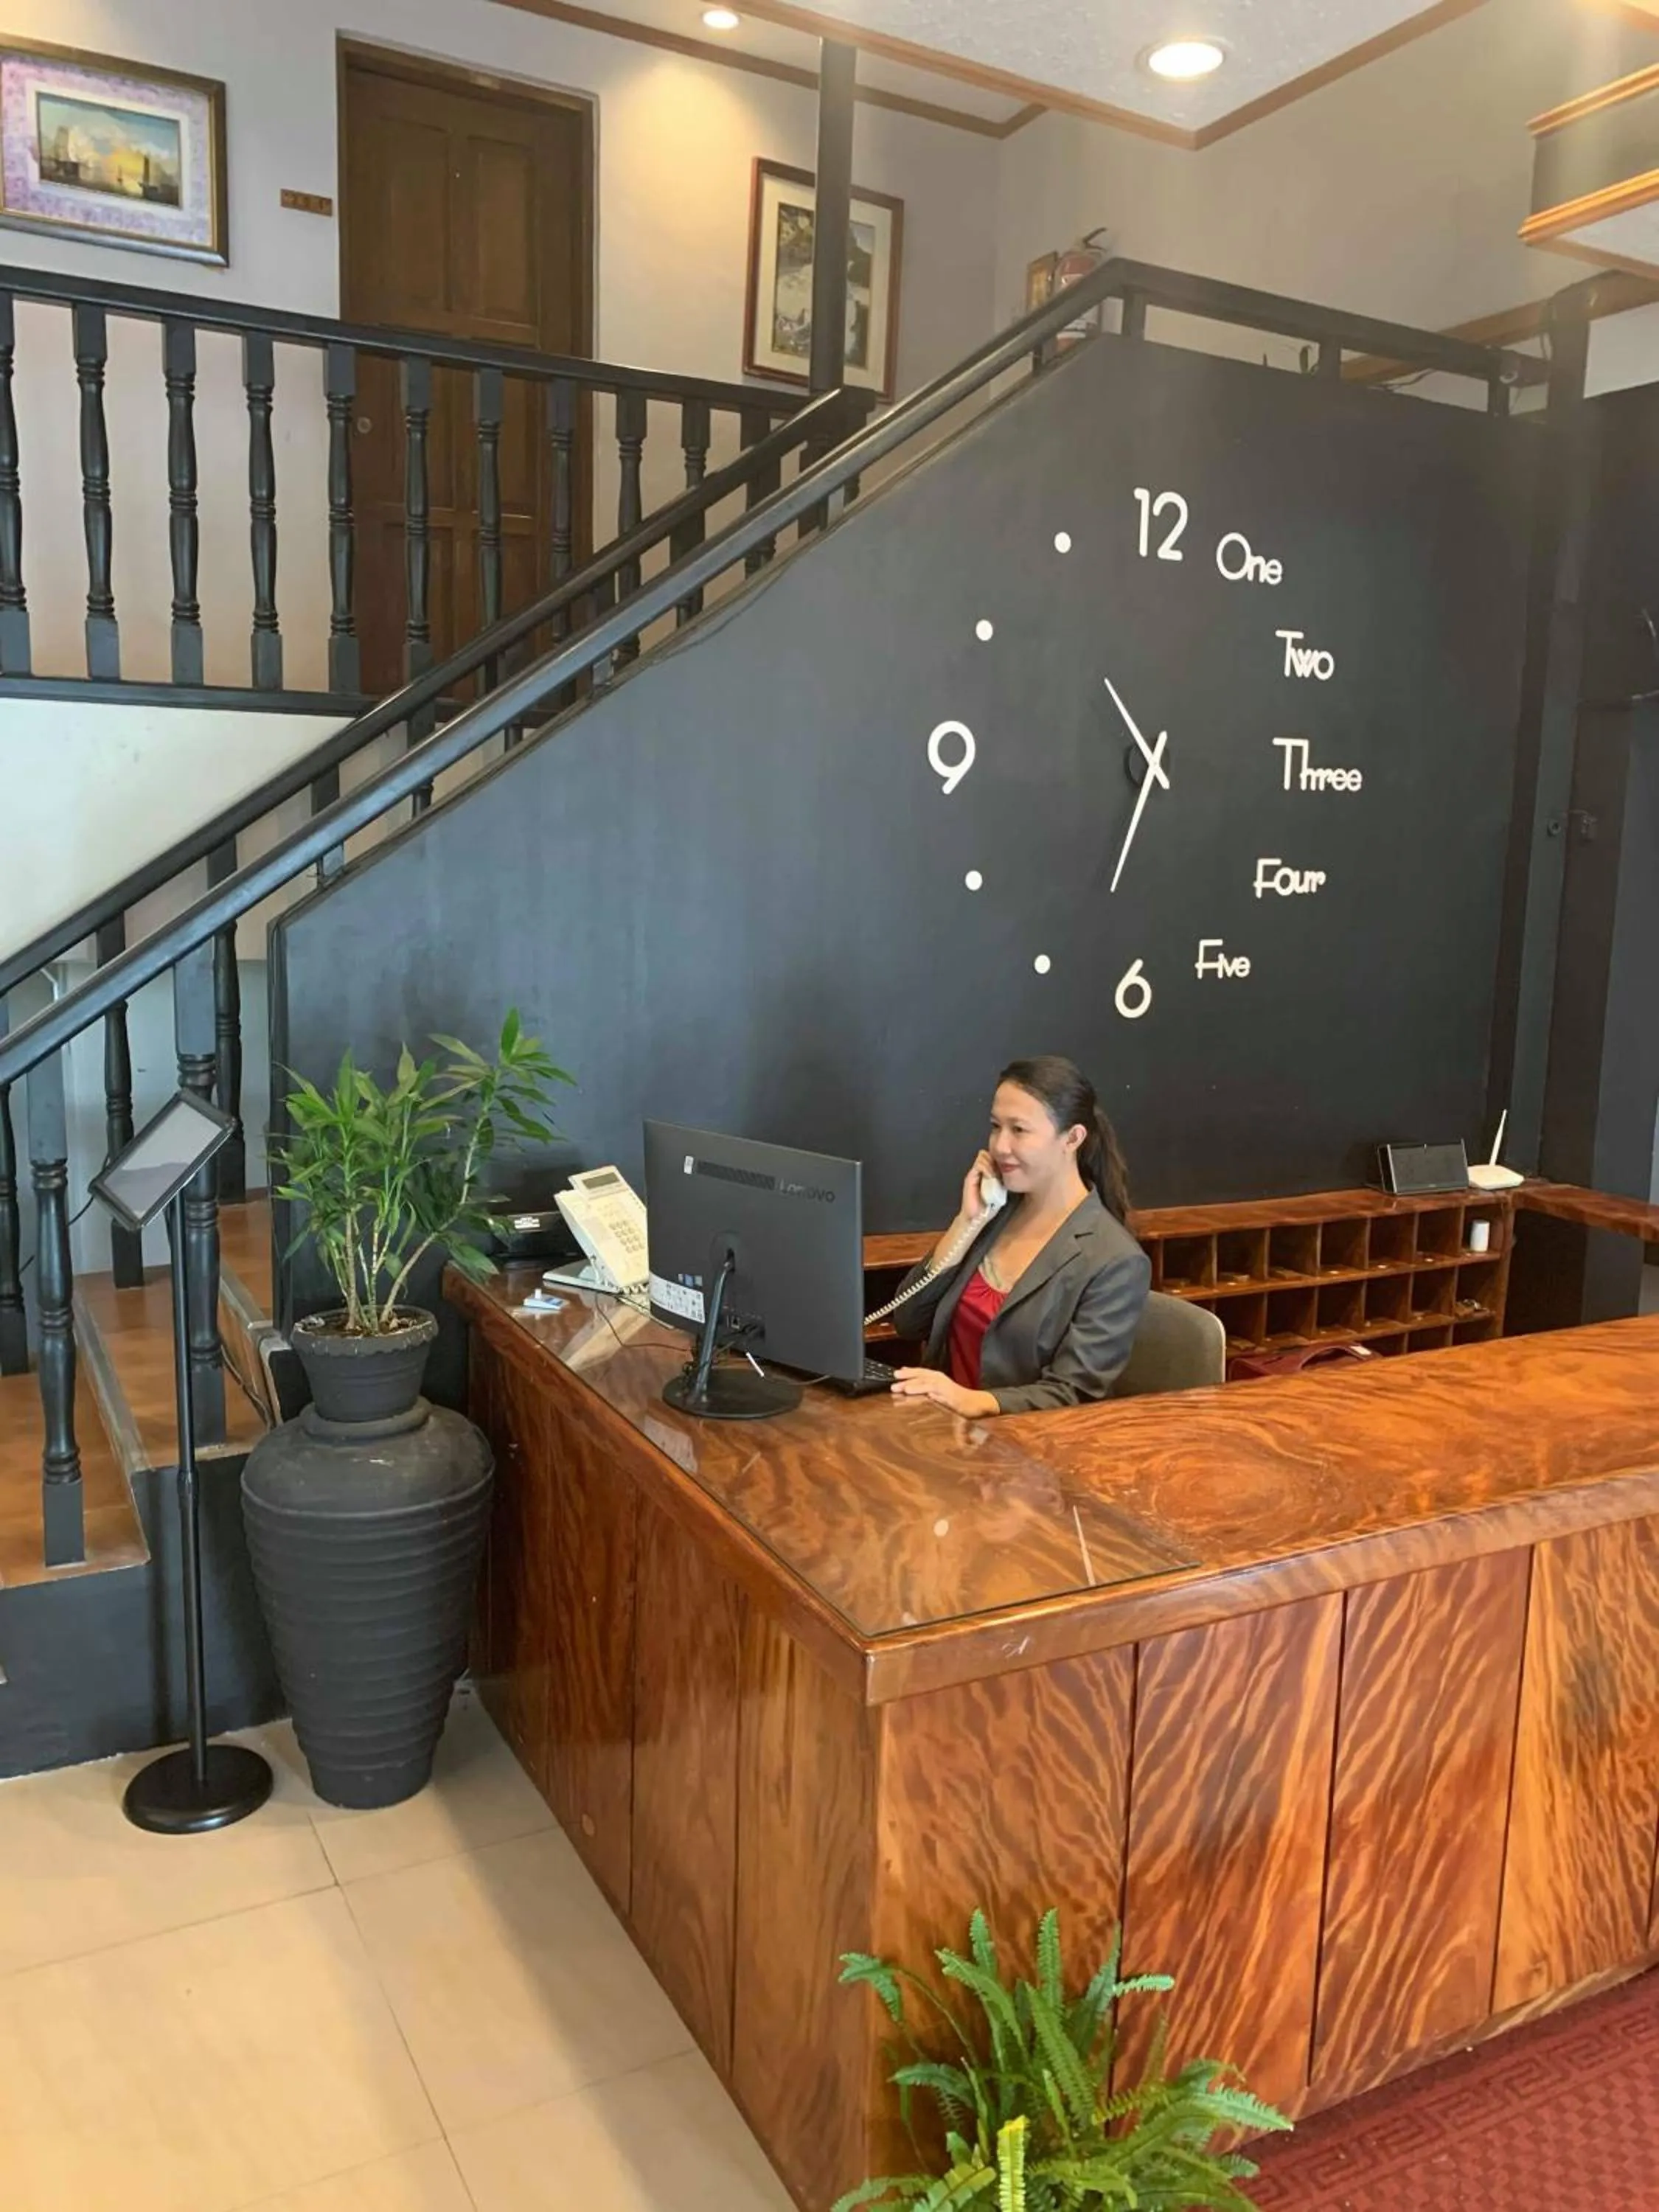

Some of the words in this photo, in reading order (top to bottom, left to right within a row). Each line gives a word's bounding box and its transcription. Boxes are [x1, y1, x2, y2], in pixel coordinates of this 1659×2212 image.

[1133, 487, 1189, 561] 12
[1216, 532, 1283, 585] One
[1275, 629, 1335, 681] Two
[927, 720, 976, 795] 9
[1272, 737, 1363, 792] Three
[1253, 858, 1326, 899] Four
[1194, 939, 1251, 979] Five
[1114, 959, 1152, 1018] 6
